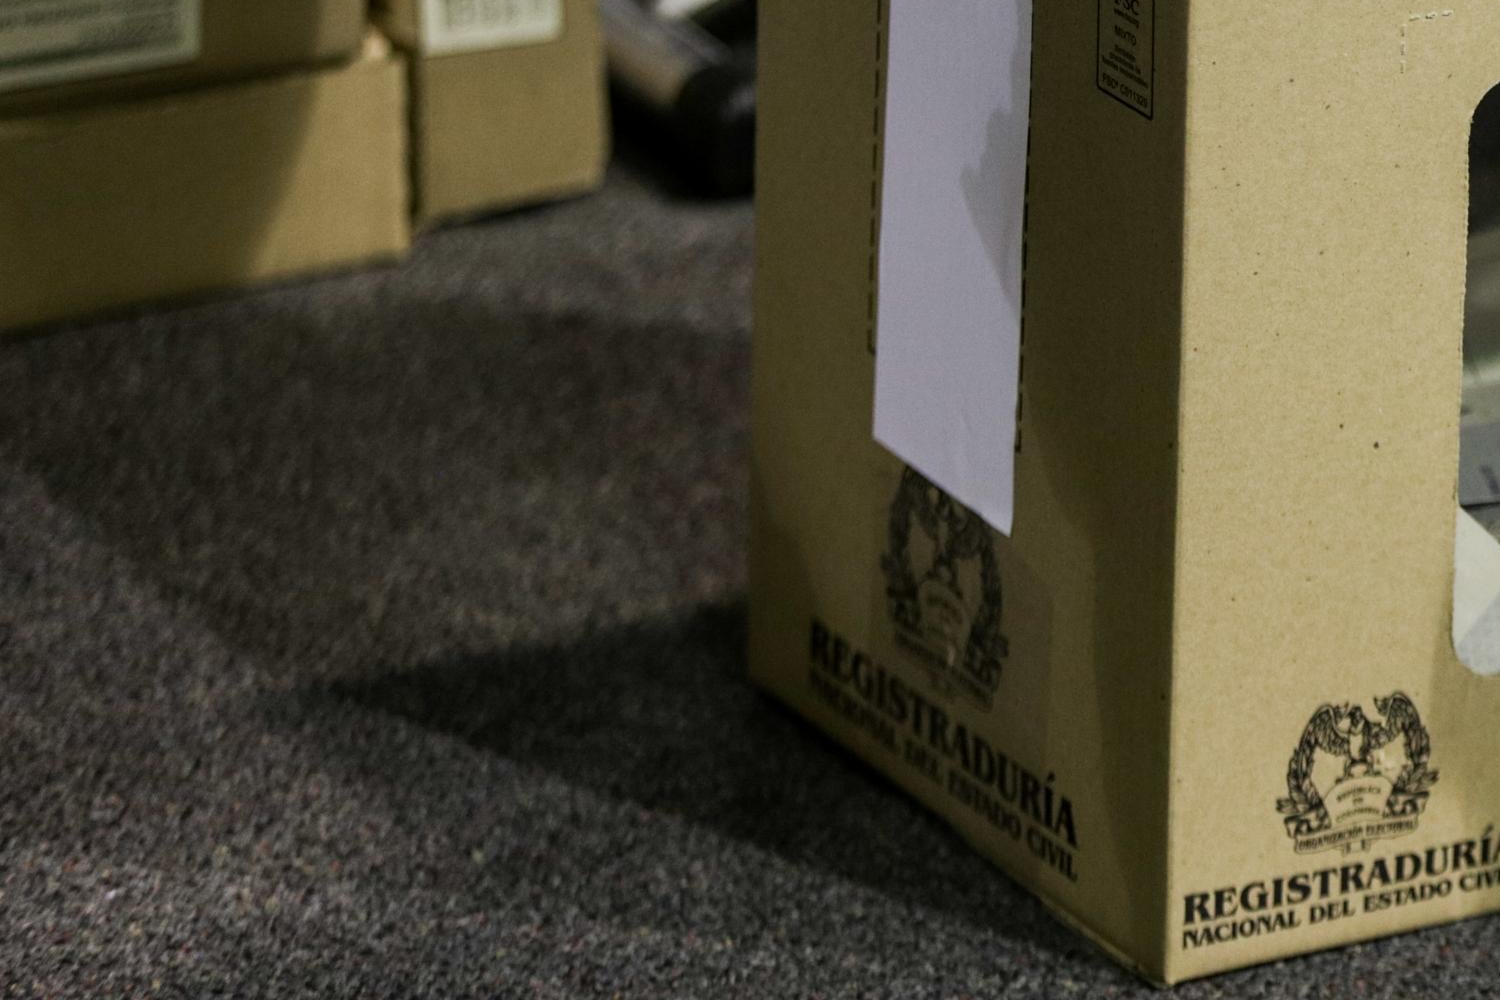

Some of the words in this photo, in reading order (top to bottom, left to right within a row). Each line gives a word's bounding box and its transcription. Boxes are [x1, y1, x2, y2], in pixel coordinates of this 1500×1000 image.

[808, 616, 1079, 850] REGISTRADURÍA
[1027, 826, 1079, 883] CIVIL
[1181, 911, 1301, 951] NACIONAL
[1308, 900, 1357, 925] DEL
[1363, 880, 1452, 914] ESTADO
